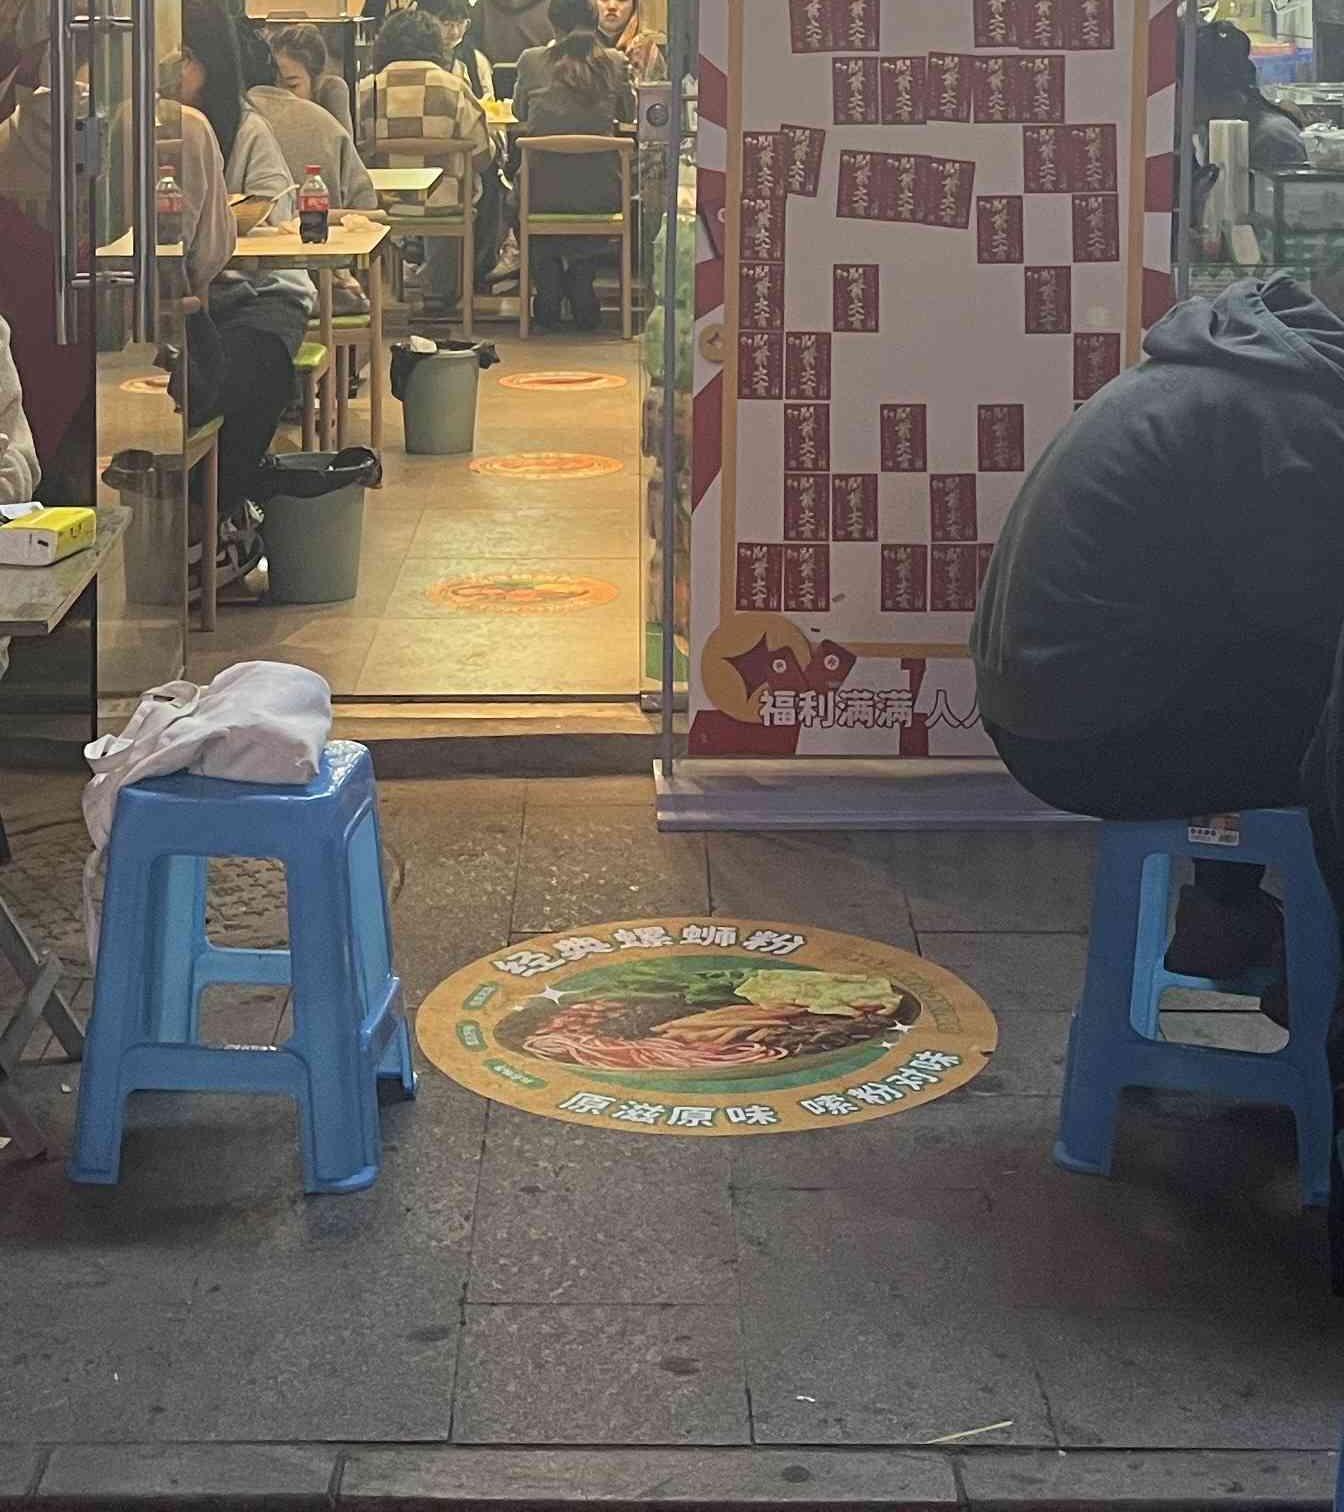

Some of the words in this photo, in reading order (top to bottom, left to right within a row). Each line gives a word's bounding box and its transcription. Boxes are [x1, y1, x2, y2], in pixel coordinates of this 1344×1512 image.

[758, 687, 913, 730] 福利满满
[493, 924, 806, 979] 经典螺蛳粉
[557, 1089, 779, 1129] 原滋原味
[802, 1049, 961, 1119] 嗦粉对味
